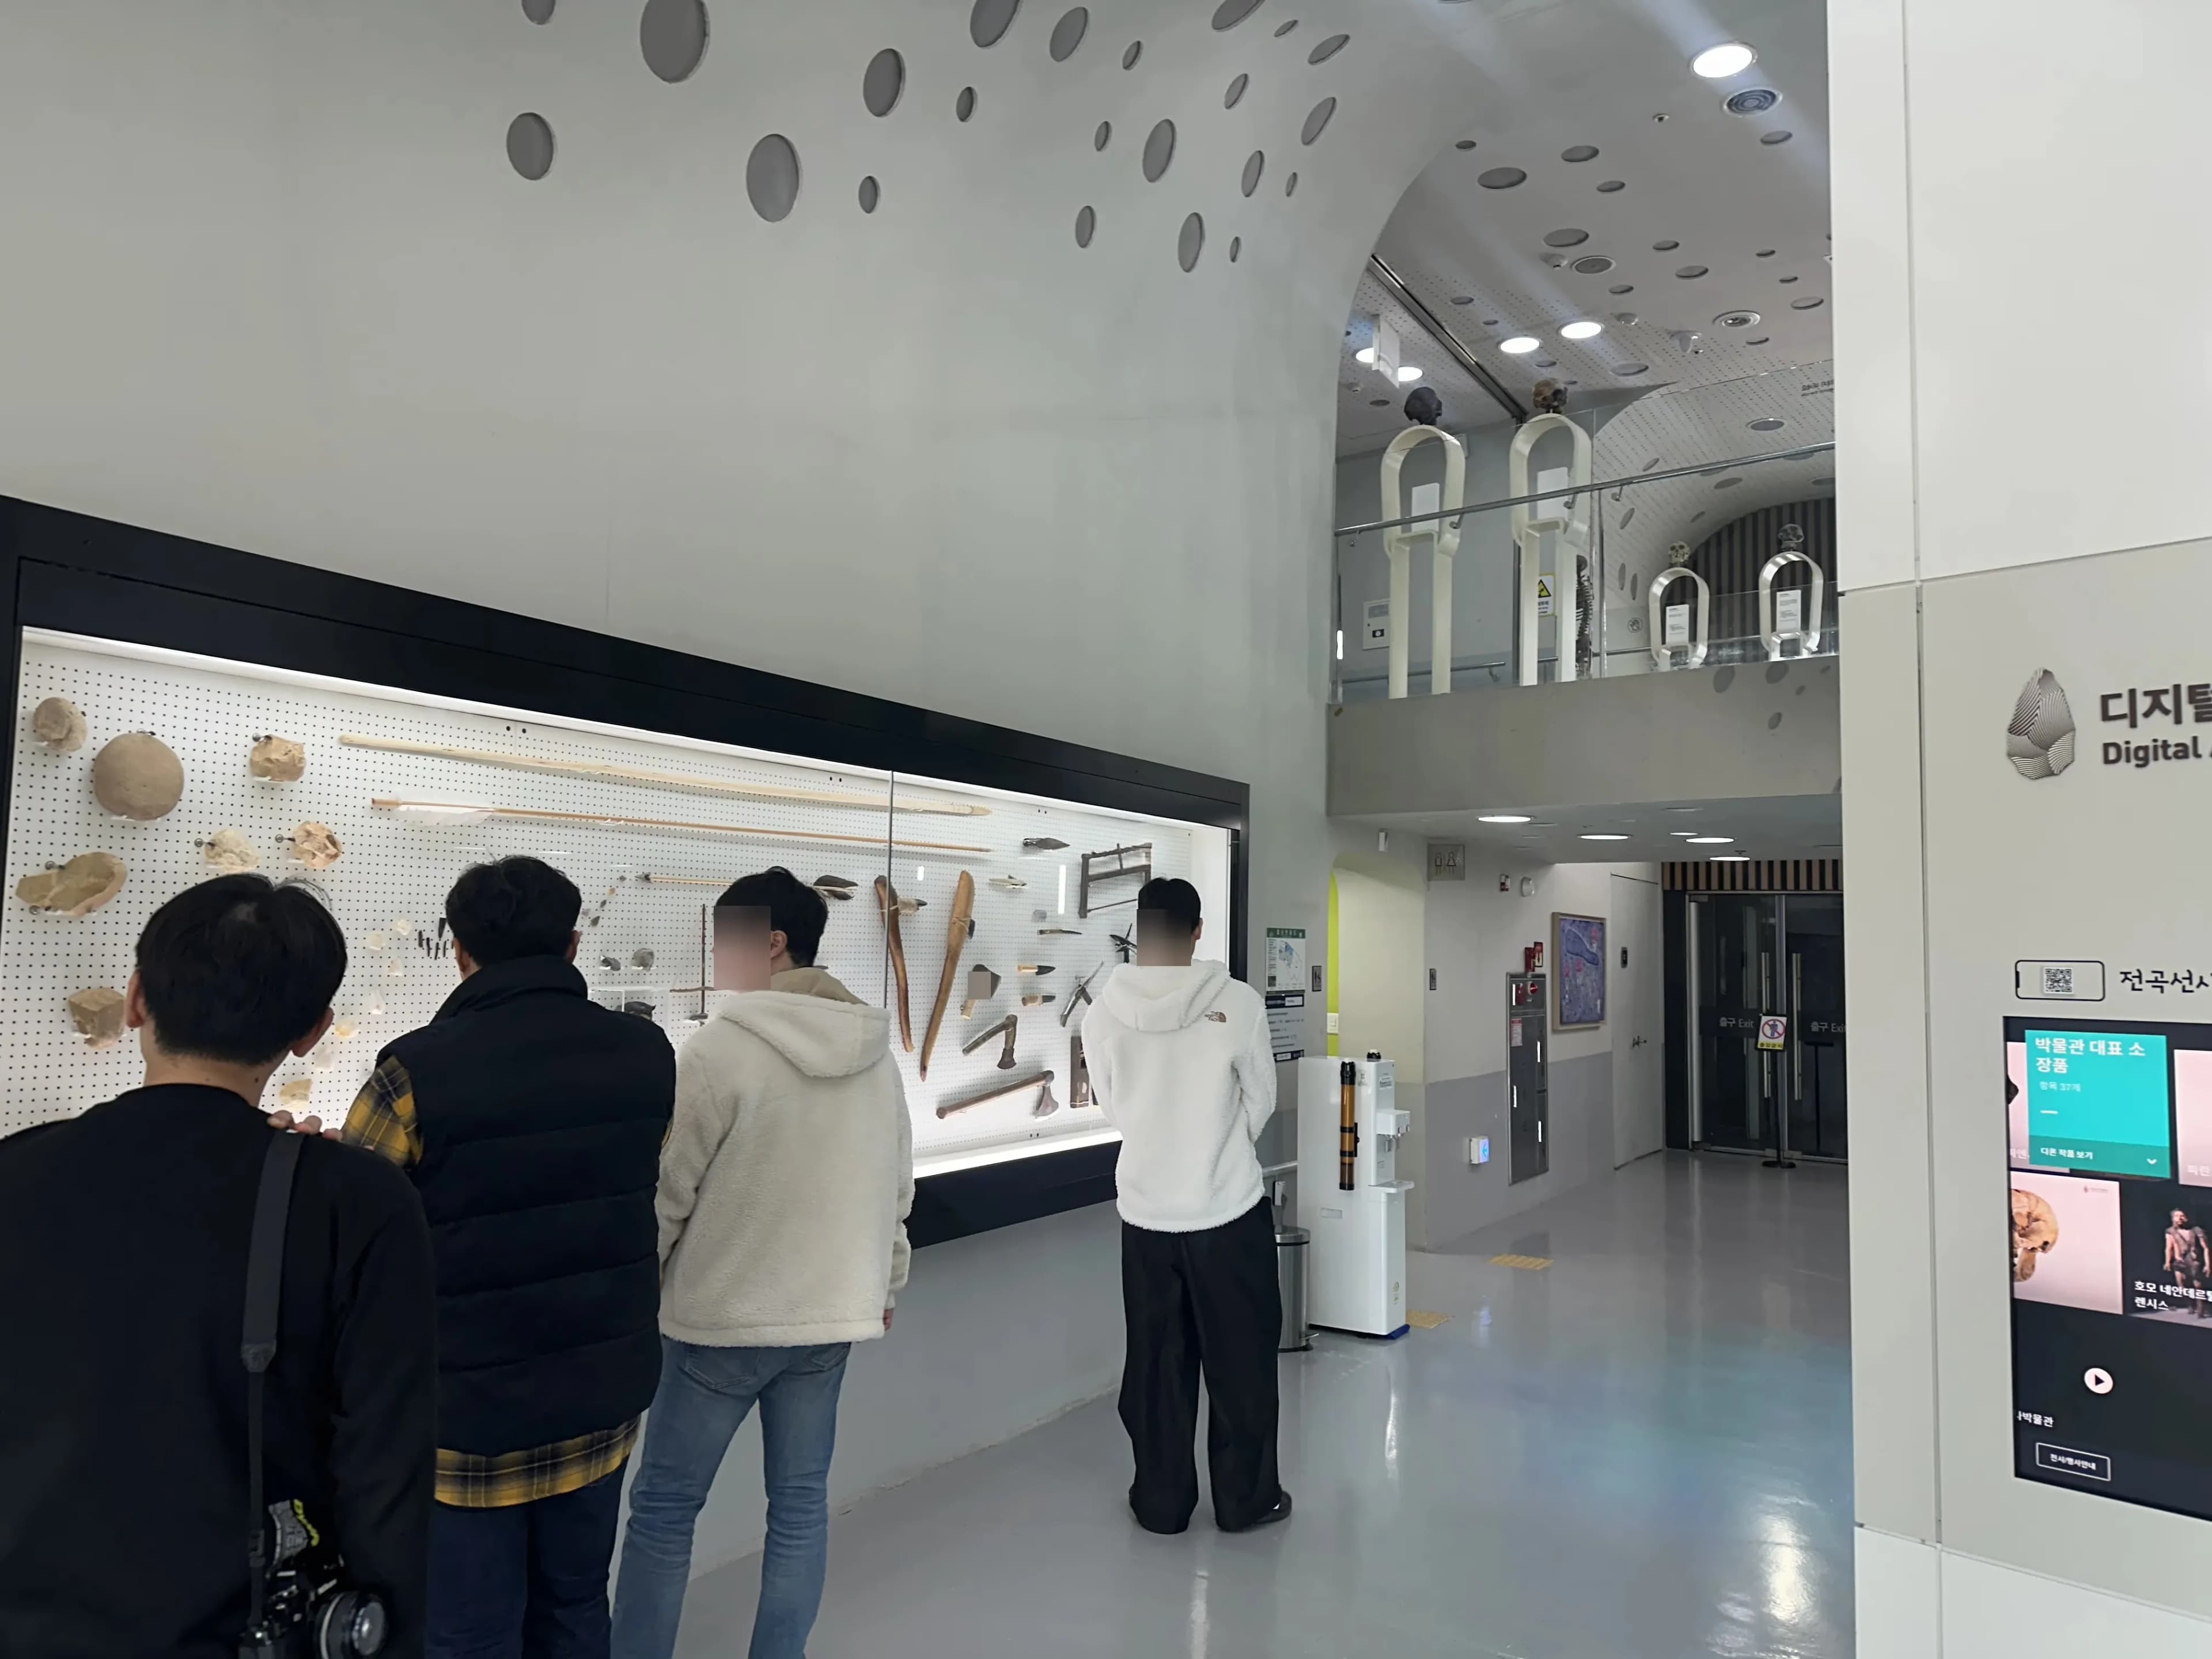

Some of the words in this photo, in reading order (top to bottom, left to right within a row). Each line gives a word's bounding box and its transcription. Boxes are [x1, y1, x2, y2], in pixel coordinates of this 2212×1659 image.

[2102, 736, 2202, 768] Digital
[1738, 1018, 1755, 1028] Exit
[1831, 1023, 1846, 1032] Exi
[2035, 1037, 2085, 1055] 박물관
[2090, 1040, 2124, 1055] 대표
[2128, 1042, 2146, 1056] 소
[2036, 1058, 2069, 1074] 장품
[2040, 1147, 2056, 1156] 다른
[2058, 1149, 2075, 1158] 작품
[2077, 1151, 2093, 1160] 보기
[2134, 1281, 2157, 1293] 호모
[2134, 1297, 2169, 1310] 렌시스
